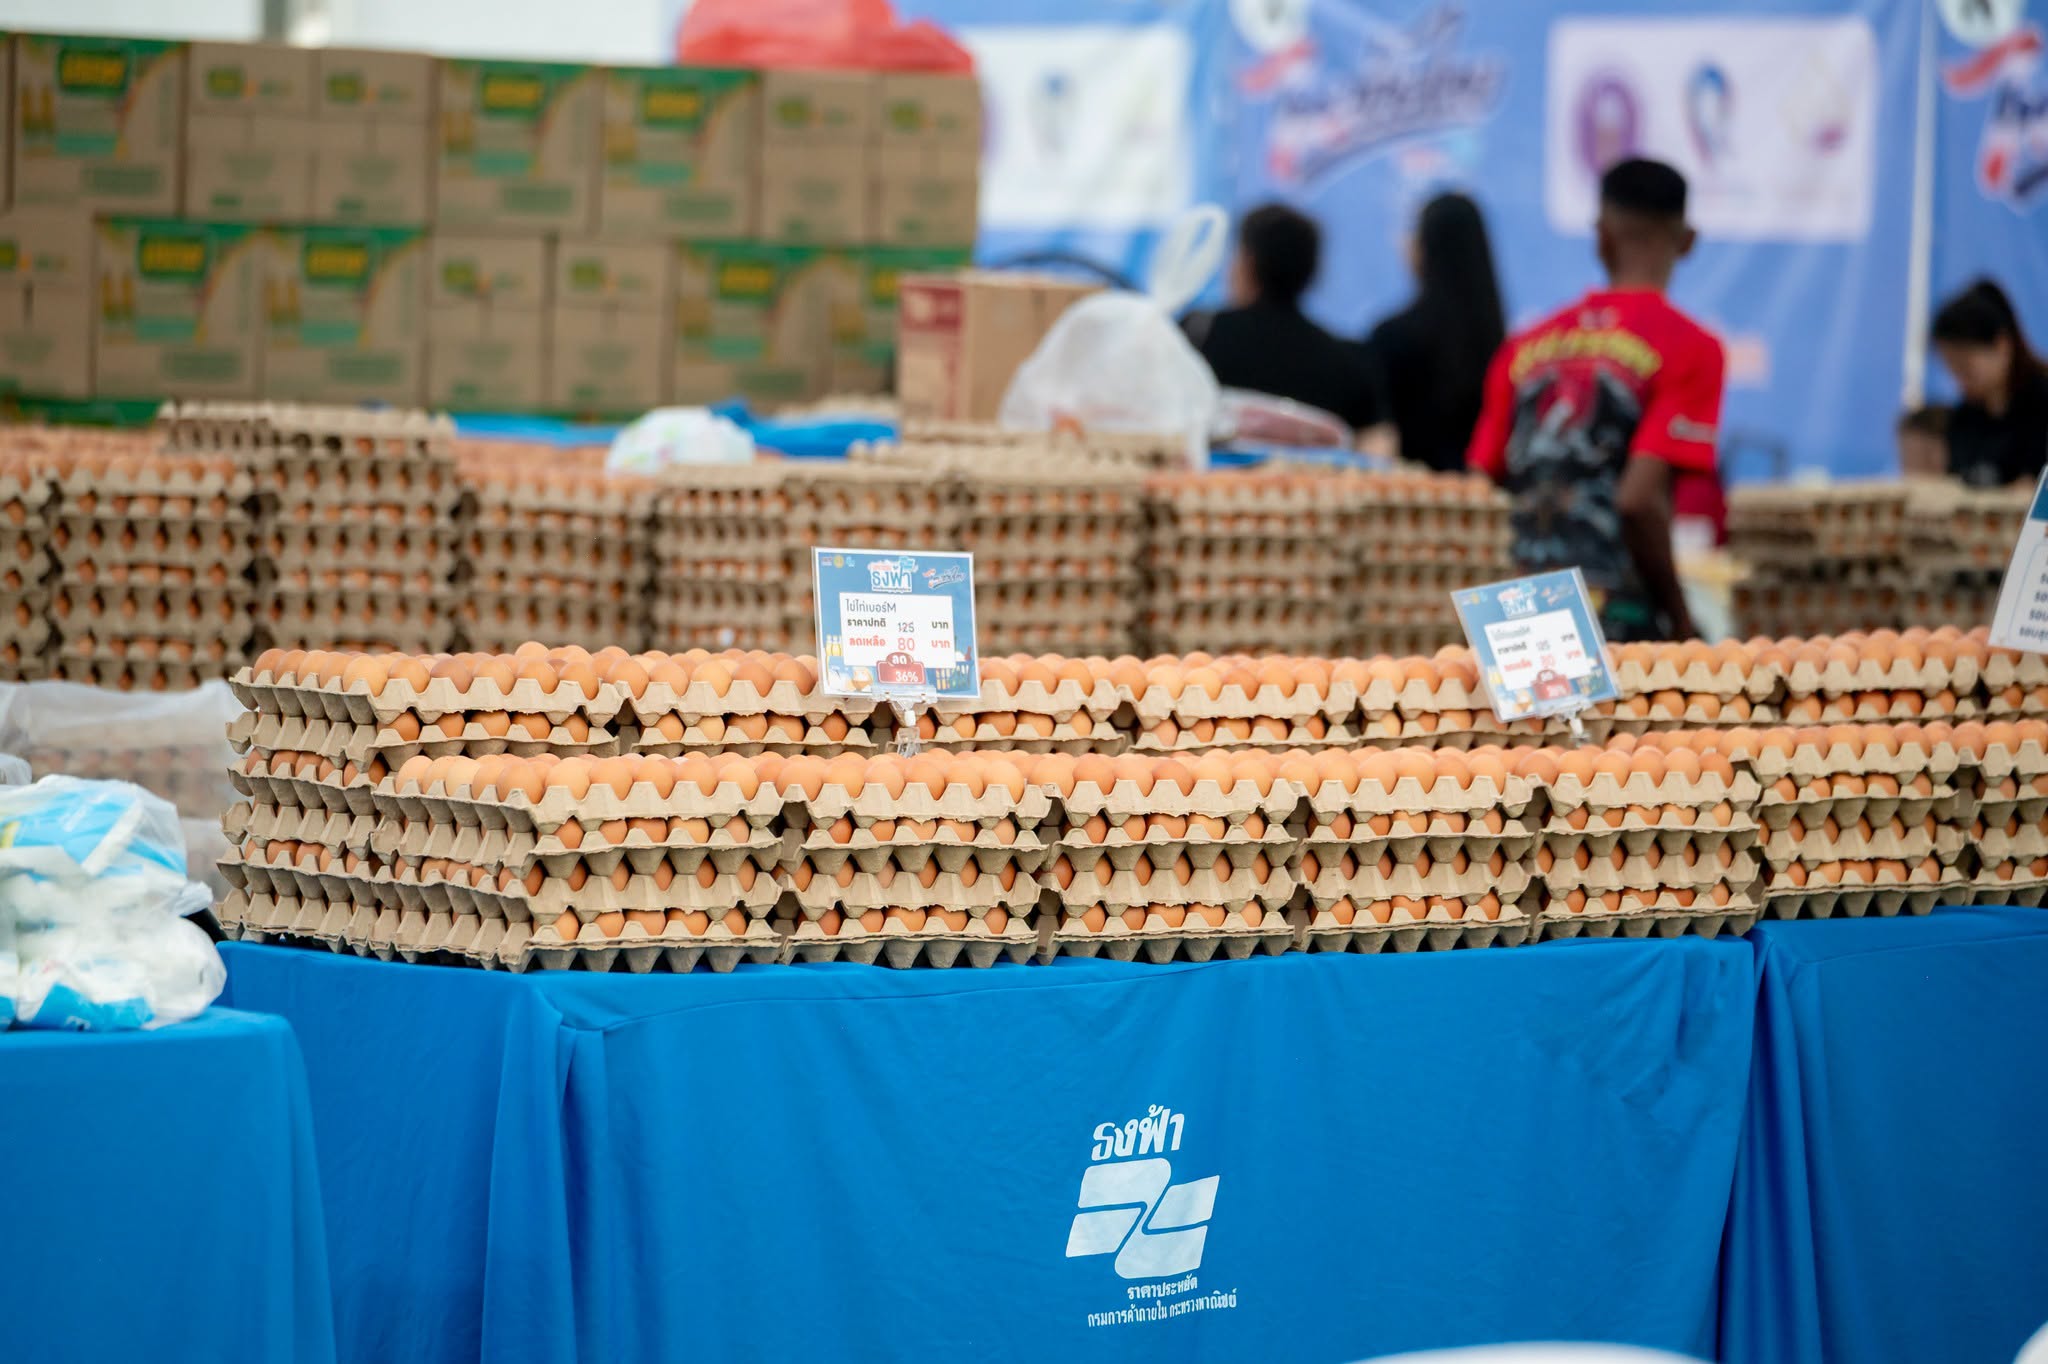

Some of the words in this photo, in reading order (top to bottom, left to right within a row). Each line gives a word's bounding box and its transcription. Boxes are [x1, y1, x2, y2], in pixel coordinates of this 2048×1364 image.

[872, 562, 911, 587] ธงฟ้า
[847, 618, 886, 627] ราคาปกติ
[897, 622, 915, 632] 125
[931, 621, 949, 629] บาท
[849, 635, 886, 647] ลดเหลือ
[897, 637, 915, 651] 80
[931, 639, 950, 648] บาท
[895, 671, 918, 682] 36%
[1091, 1104, 1185, 1161] ธงฟ้า
[1127, 1273, 1198, 1299] ราคาประหยัด
[1087, 1300, 1168, 1328] กรมการค้าภายใน
[1169, 1288, 1238, 1318] กระทรวงพาณิชย์
